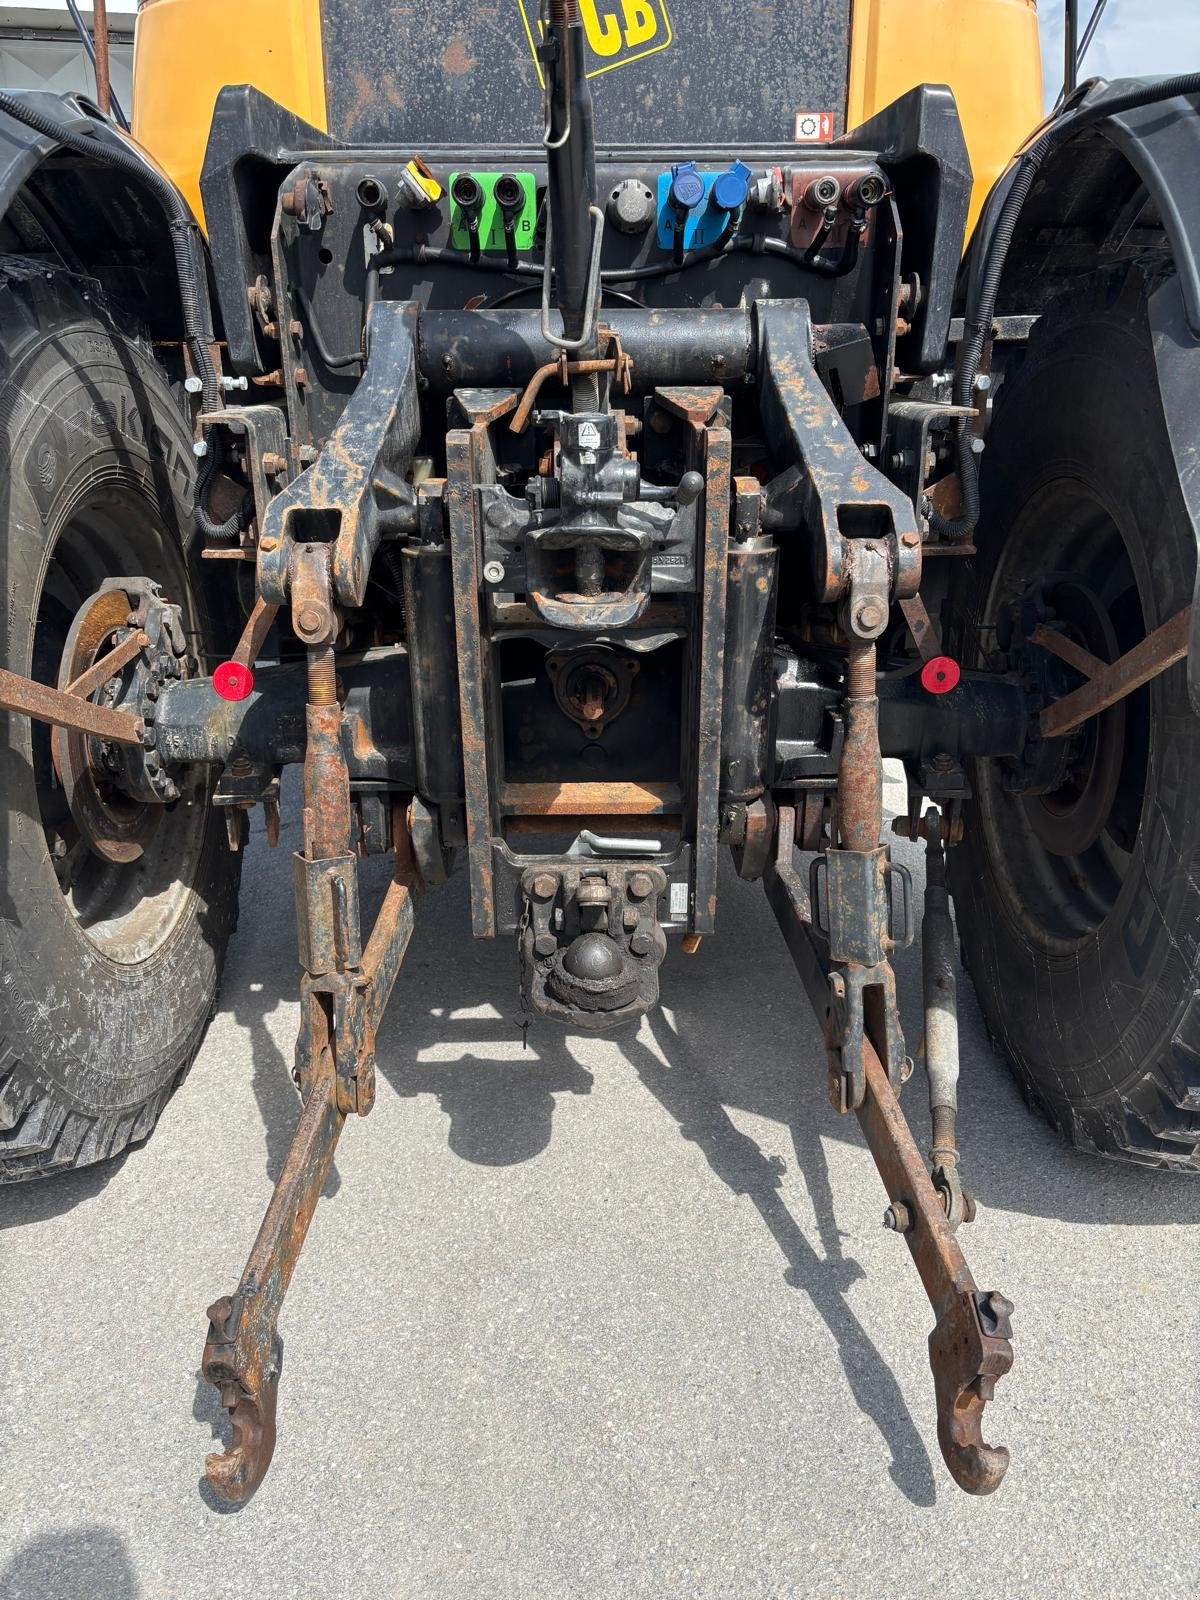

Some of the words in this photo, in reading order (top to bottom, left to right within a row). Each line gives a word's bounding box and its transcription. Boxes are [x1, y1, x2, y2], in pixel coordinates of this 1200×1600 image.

[538, 0, 657, 57] CB
[522, 220, 531, 231] B
[664, 220, 673, 231] A
